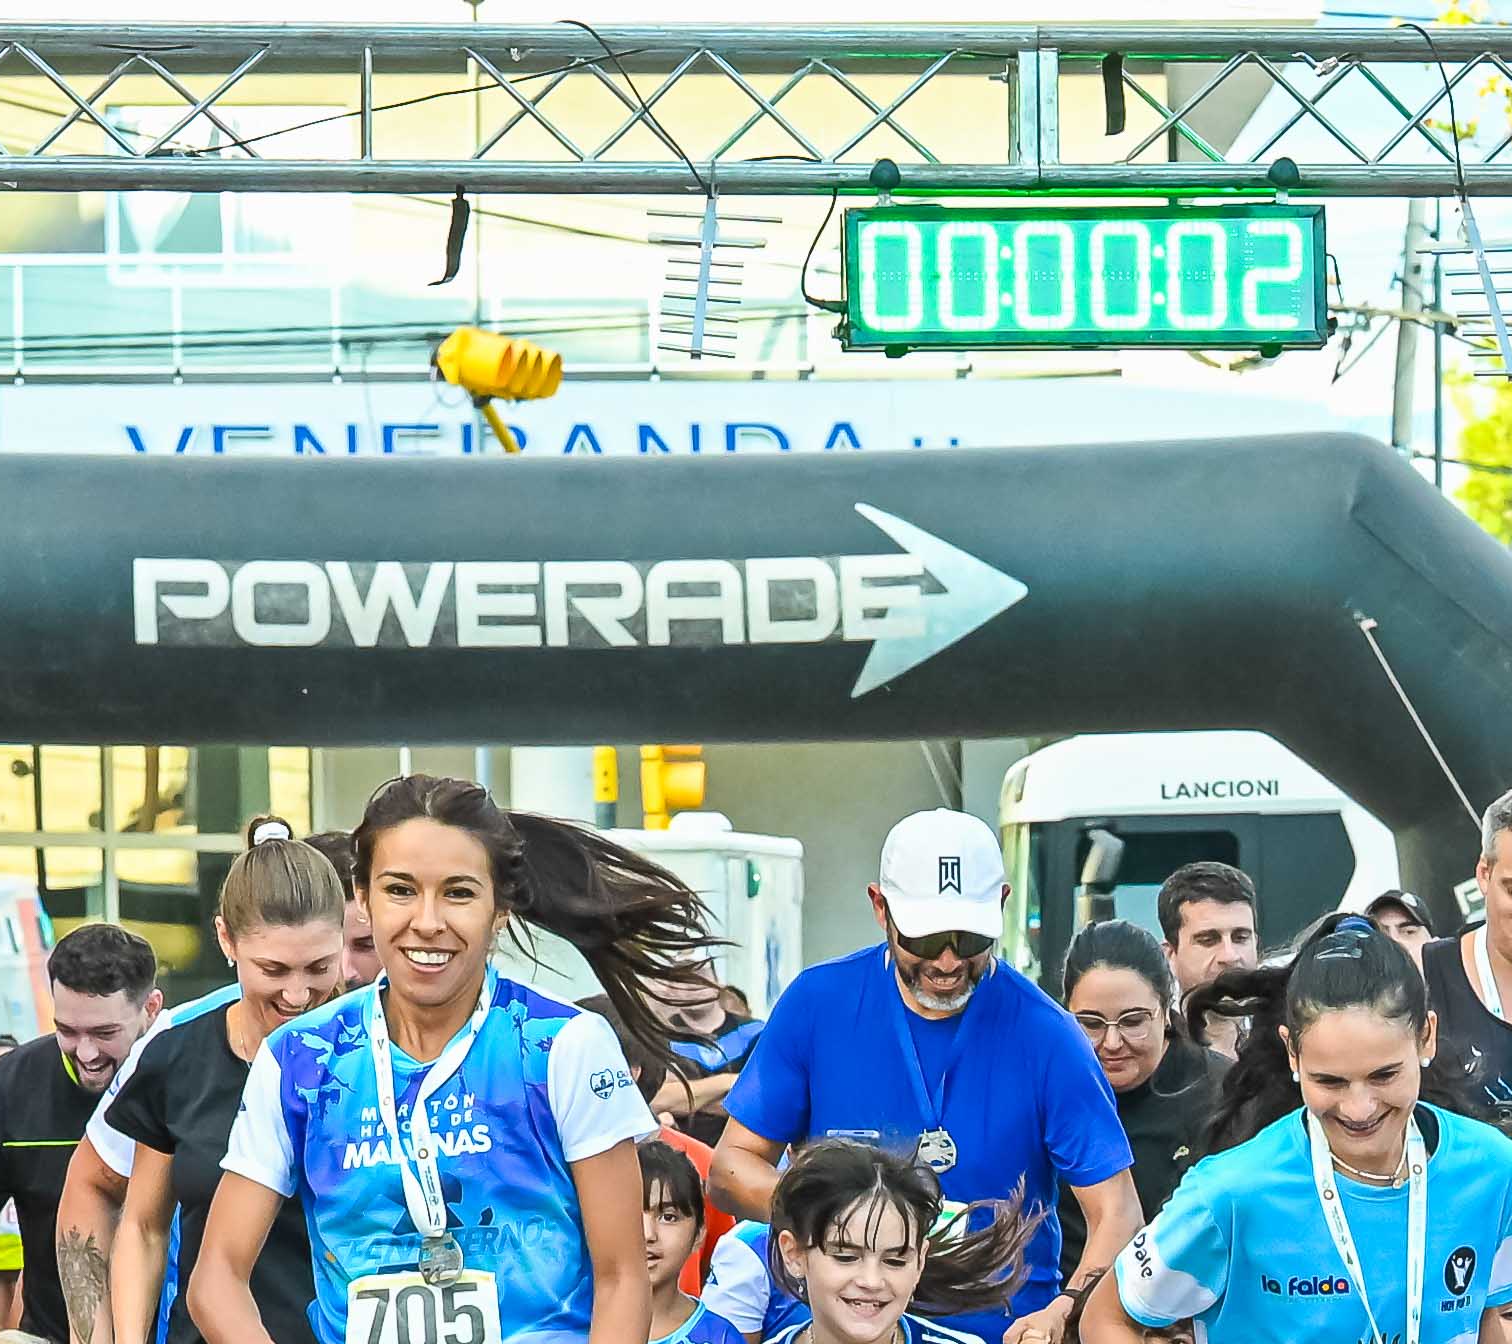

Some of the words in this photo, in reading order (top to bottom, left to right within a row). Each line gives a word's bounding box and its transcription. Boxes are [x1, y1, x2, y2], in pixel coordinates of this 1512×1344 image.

[860, 220, 1304, 331] 00:00:02
[133, 554, 926, 647] POWERADE
[1161, 780, 1279, 799] LANCIONI
[361, 1092, 476, 1122] MRTÓN
[1133, 1232, 1153, 1280] Dale
[1262, 1275, 1281, 1295] la
[1288, 1275, 1350, 1297] falda
